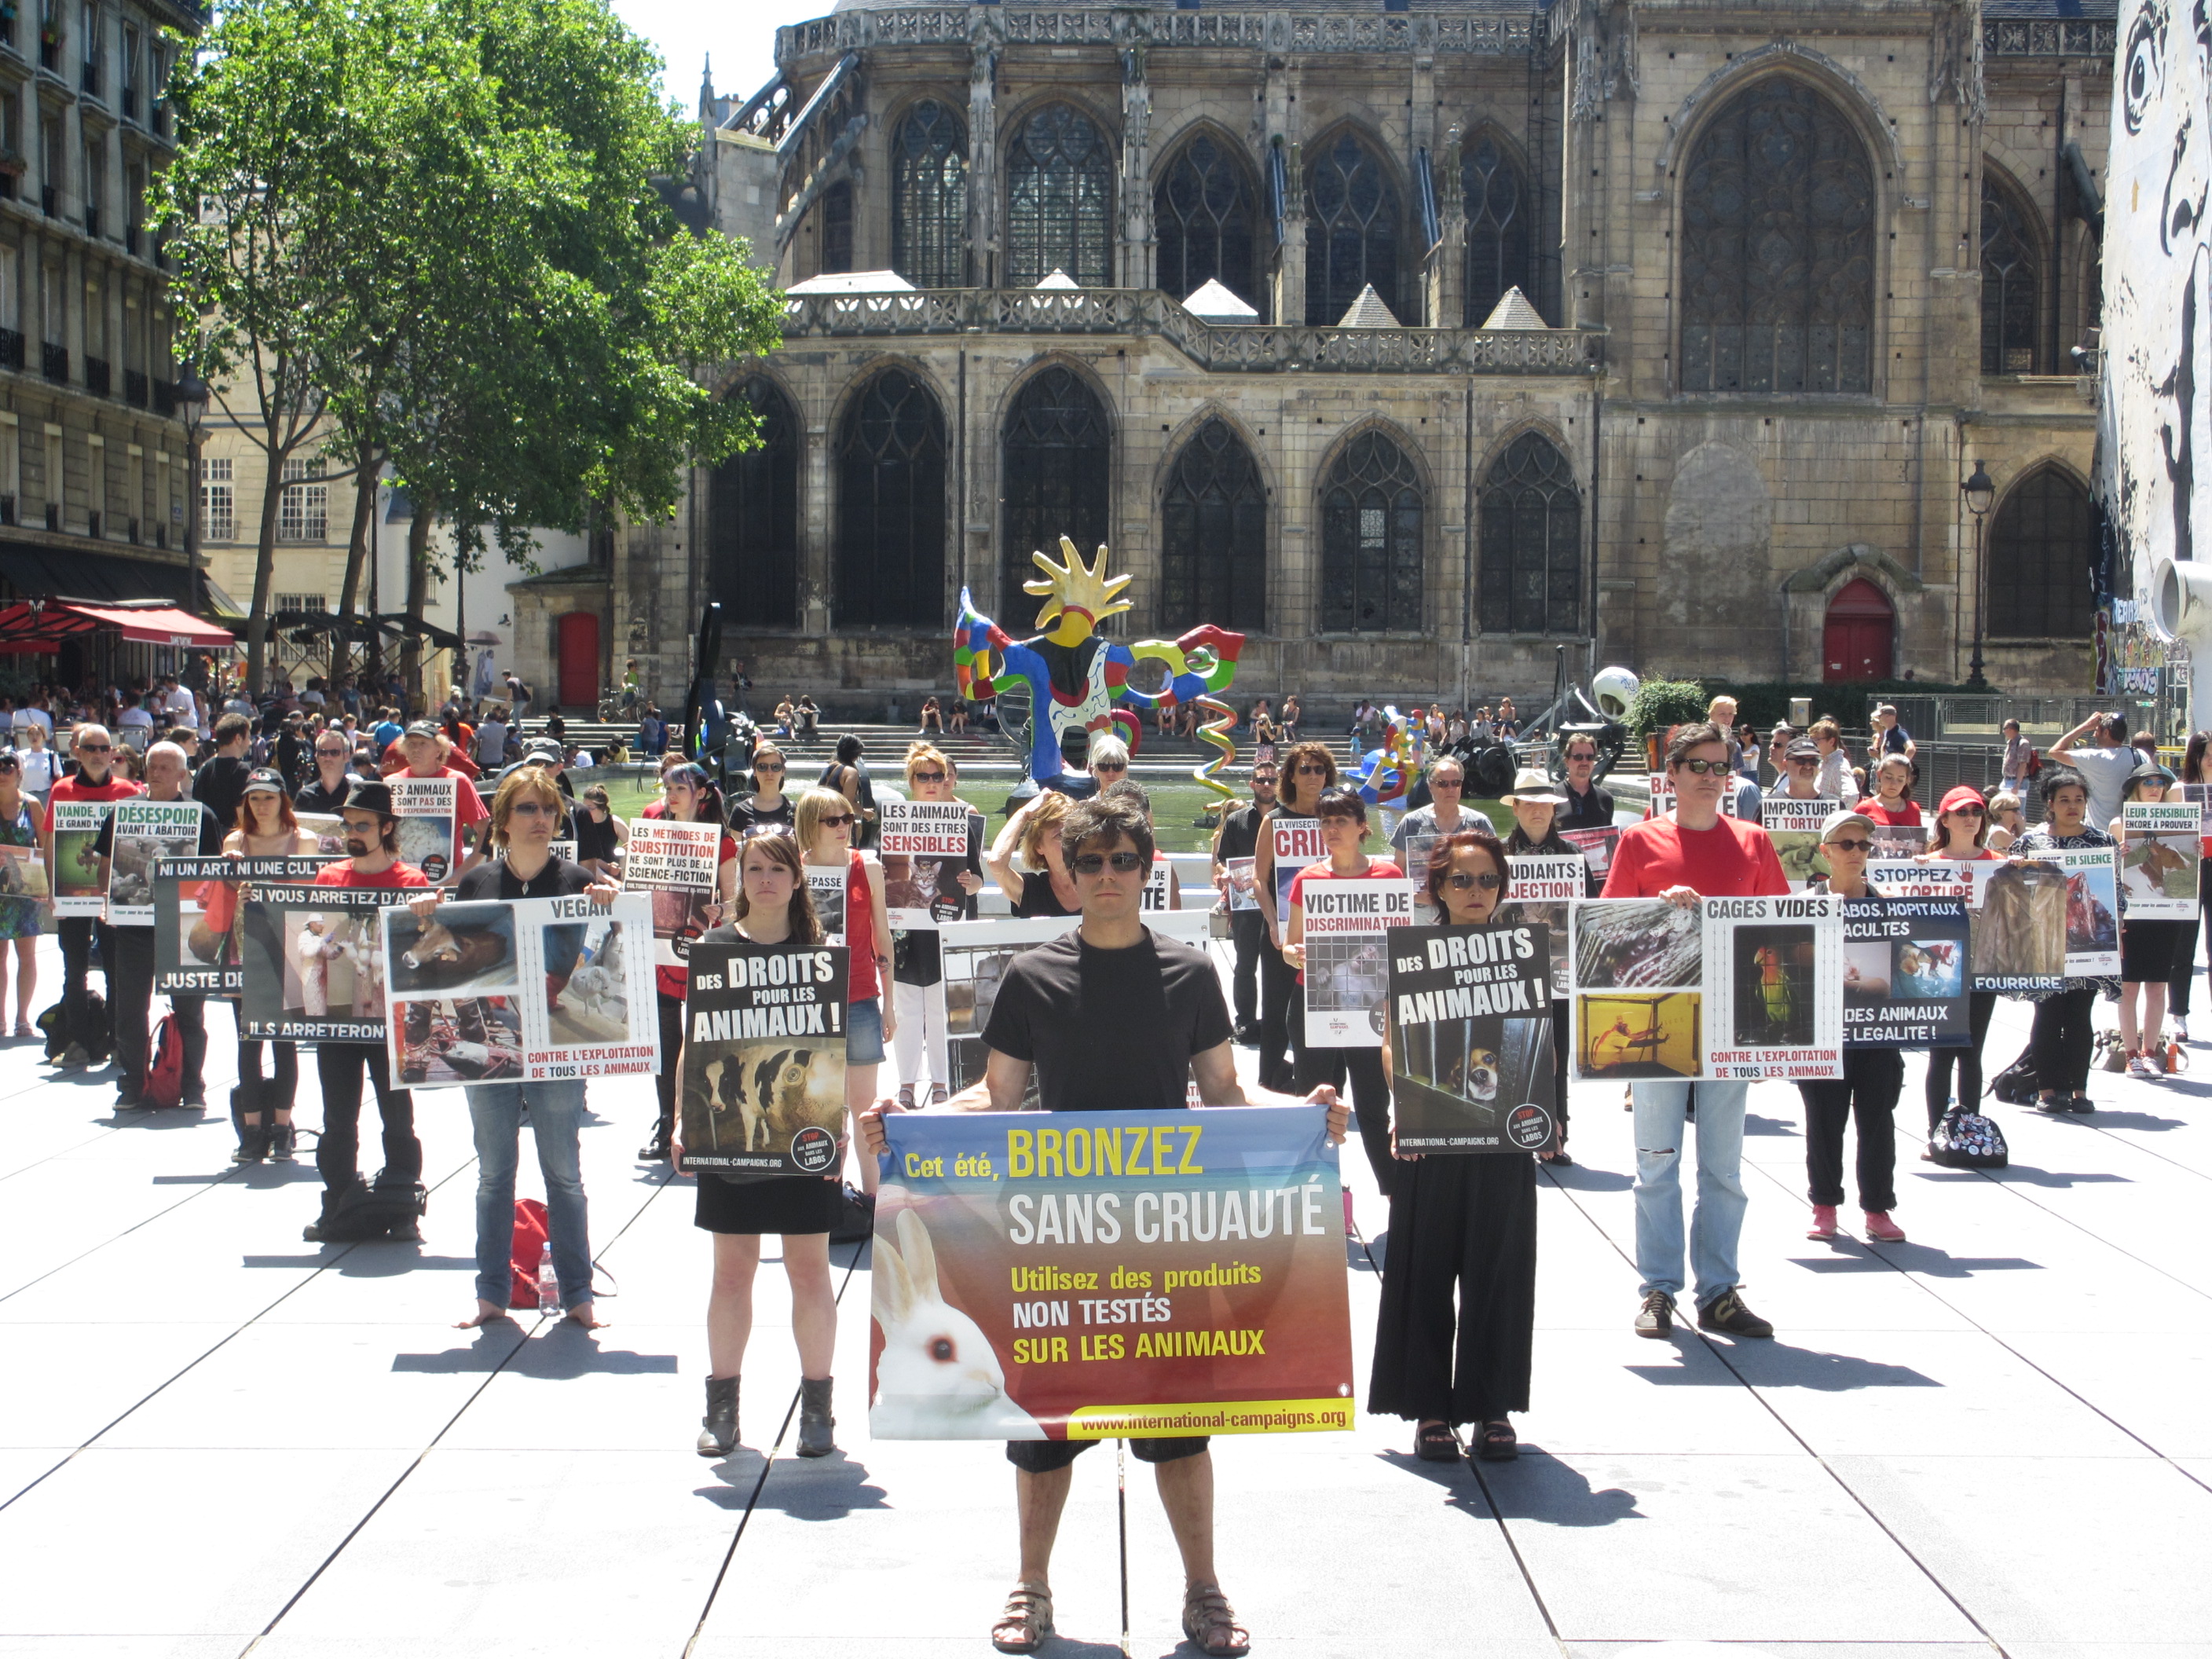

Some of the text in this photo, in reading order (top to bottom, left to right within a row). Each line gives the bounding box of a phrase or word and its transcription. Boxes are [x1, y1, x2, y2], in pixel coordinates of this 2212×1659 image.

[407, 785, 452, 796] ANIMAUX
[397, 797, 417, 806] SONT
[419, 797, 435, 806] PAS
[437, 797, 452, 806] DES
[56, 806, 96, 818] VIANDE,
[118, 803, 199, 825] DÉSESPOIR
[883, 805, 967, 819] LES ANIMAUX
[2126, 805, 2199, 819] LEUR SENSIBILITÉ
[116, 825, 145, 835] AVANT
[883, 822, 966, 833] SONT DES ETRES
[1284, 820, 1321, 829] VIVISECTI
[1764, 818, 1826, 830] ET TORTU
[2126, 820, 2152, 829] ENCORE
[2153, 819, 2159, 829] À
[632, 826, 716, 842] LES MÉTHODES DE
[630, 840, 715, 859] SUBSTITUTION
[882, 835, 966, 853] SENSIBLES
[629, 855, 713, 870] NE SONT PLUS DE LA
[2065, 855, 2077, 866] EN
[2078, 854, 2112, 866] SILENCE
[159, 862, 173, 876] NI
[178, 862, 197, 876] UN
[200, 862, 234, 877] ART,
[237, 861, 251, 876] NI
[255, 861, 284, 875] UNE
[628, 866, 712, 884] SCIENCE-FICTION
[1154, 870, 1166, 881] DE
[1873, 868, 1953, 883] STOPPEZ
[251, 889, 378, 904] SI VOUS ARRETEZ
[1579, 881, 1584, 897] !
[551, 898, 613, 919] VEGAN
[1305, 892, 1409, 914] VICTIME DE
[1707, 899, 1842, 919] CAGES VIDES !
[1887, 903, 1961, 917] HOPITAUX
[1306, 916, 1412, 932] DISCRIMINATION
[1396, 954, 1424, 974] DES
[1426, 928, 1535, 970] DROITS
[696, 951, 834, 991] DES DROITS
[1454, 963, 1518, 986] POUR LES
[161, 972, 221, 989] JUSTE
[1975, 976, 2063, 991] FOURRURE
[752, 987, 816, 1005] POUR LES
[1398, 977, 1546, 1026] ANIMAUX !
[1844, 1005, 1948, 1023] DES ANIMAUX
[250, 1021, 387, 1039] ILS ARRETERON
[693, 1002, 840, 1043] ANIMAUX !
[1853, 1026, 1928, 1042] LEGALITE
[1931, 1025, 1937, 1040] !
[527, 1046, 654, 1064] CONTRE L'EXPLOITATION
[1711, 1049, 1838, 1064] CONTRE L'EXPLOITATION
[532, 1062, 651, 1079] DE TOUS LES ANIMAUX
[1716, 1064, 1835, 1079] DE TOUS LES ANIMAUX
[1517, 1108, 1534, 1119] STOP
[1522, 1116, 1544, 1127] ANIMAUX
[802, 1131, 819, 1142] STOP
[1398, 1137, 1500, 1147] INTERNATIONAL-CAMPAIGNS.ORG
[1521, 1131, 1543, 1144] LABOS
[805, 1140, 829, 1150] ANIMAUX
[804, 1155, 826, 1166] LABOS
[905, 1126, 1203, 1181] Cet été, BRONZEZ
[683, 1156, 782, 1168] INTERNATIONAL-CAMPAIGNS.ORG
[1009, 1174, 1326, 1245] SANS CRUAUTÉ
[1010, 1262, 1262, 1294] Utilisez des produits
[1013, 1292, 1172, 1329] NON TESTÉS
[1013, 1330, 1266, 1364] SUR LES ANIMAUX
[1081, 1408, 1347, 1432] www.international-campaigns.org
